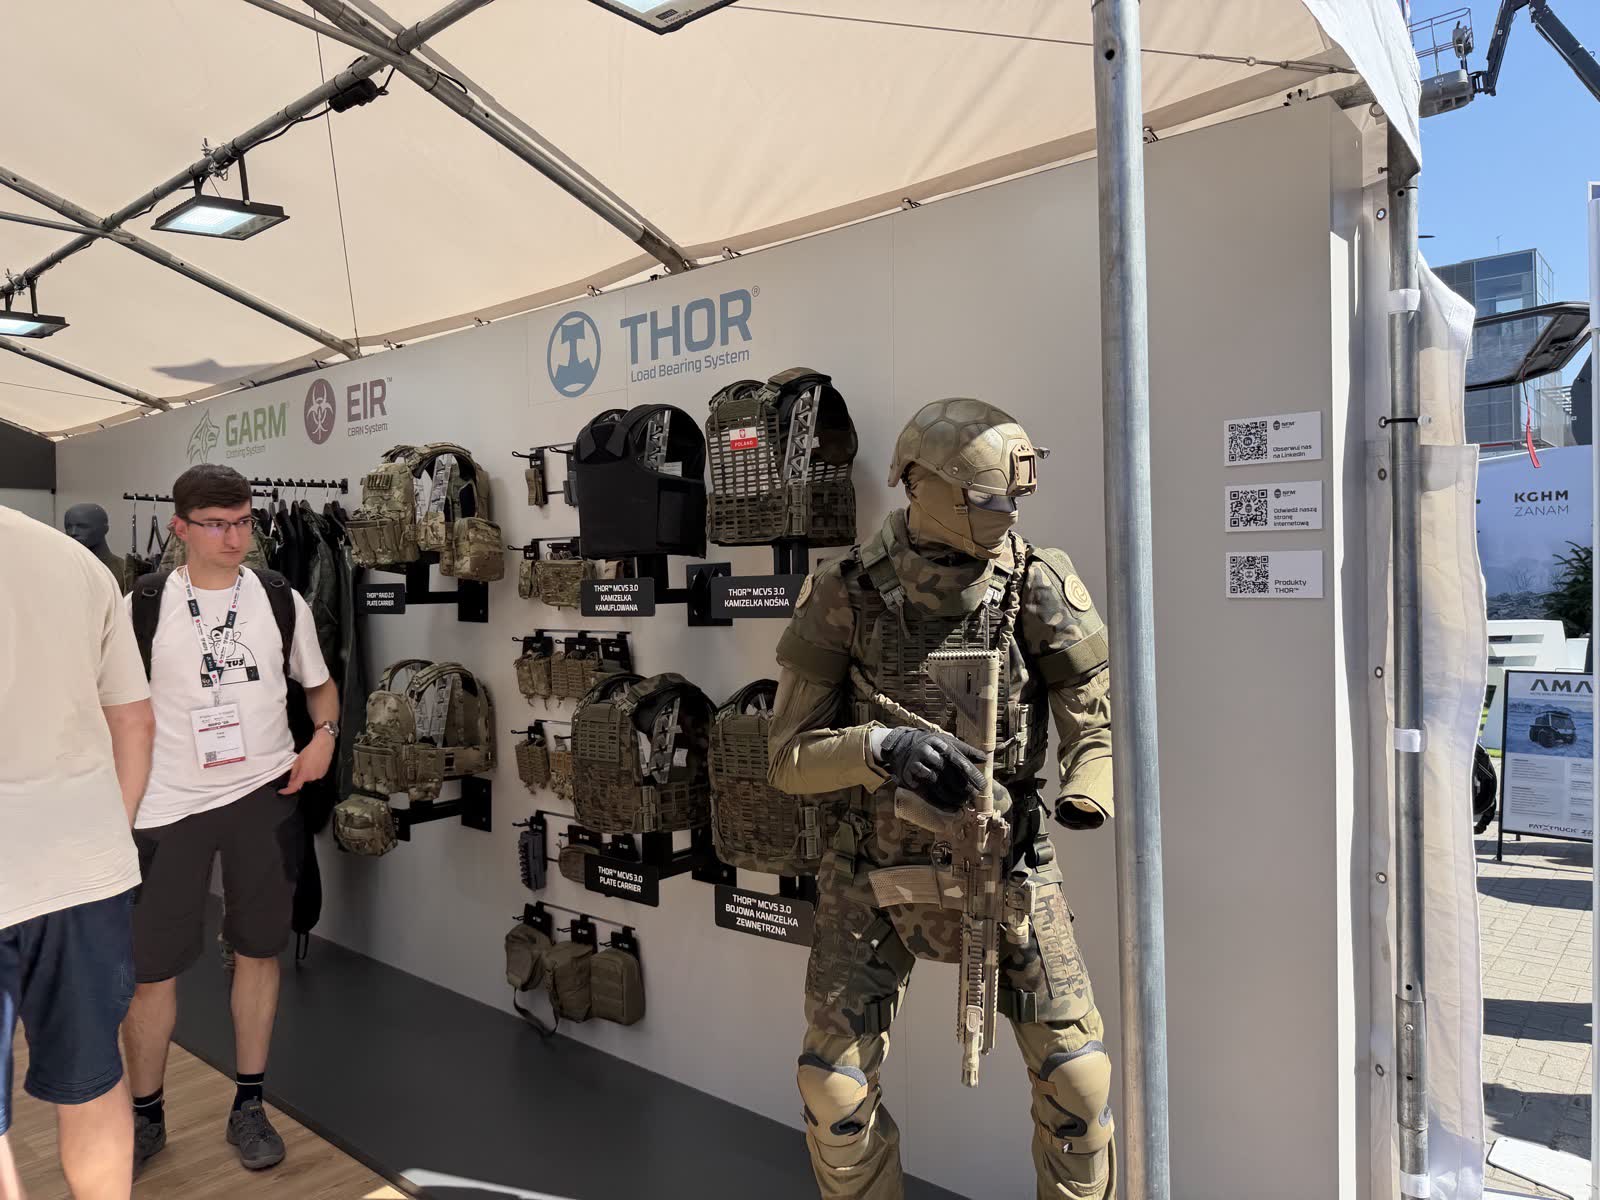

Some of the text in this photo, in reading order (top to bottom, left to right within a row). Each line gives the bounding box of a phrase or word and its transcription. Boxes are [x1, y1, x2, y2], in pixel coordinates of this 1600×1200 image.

[631, 349, 750, 382] Load Bearing System
[347, 423, 388, 437] CBRN System
[734, 440, 754, 448] POLAND
[1514, 490, 1569, 503] KGHM
[1514, 504, 1569, 517] ZANAM
[613, 584, 629, 592] MCVS
[752, 587, 773, 596] MCVS
[773, 587, 785, 595] 3.0
[600, 594, 632, 602] KAMIZELKA
[724, 597, 790, 607] KAMIZELKA NOŚNA
[617, 870, 633, 881] MCVS
[633, 873, 643, 883] 3.0
[600, 876, 642, 893] PLATE CARRIER
[757, 899, 779, 912] MCVS
[779, 904, 792, 914] 3.0
[725, 903, 799, 927] BOJOWA KAMIZELKA
[735, 917, 787, 936] ZEWNĘTRZNA
